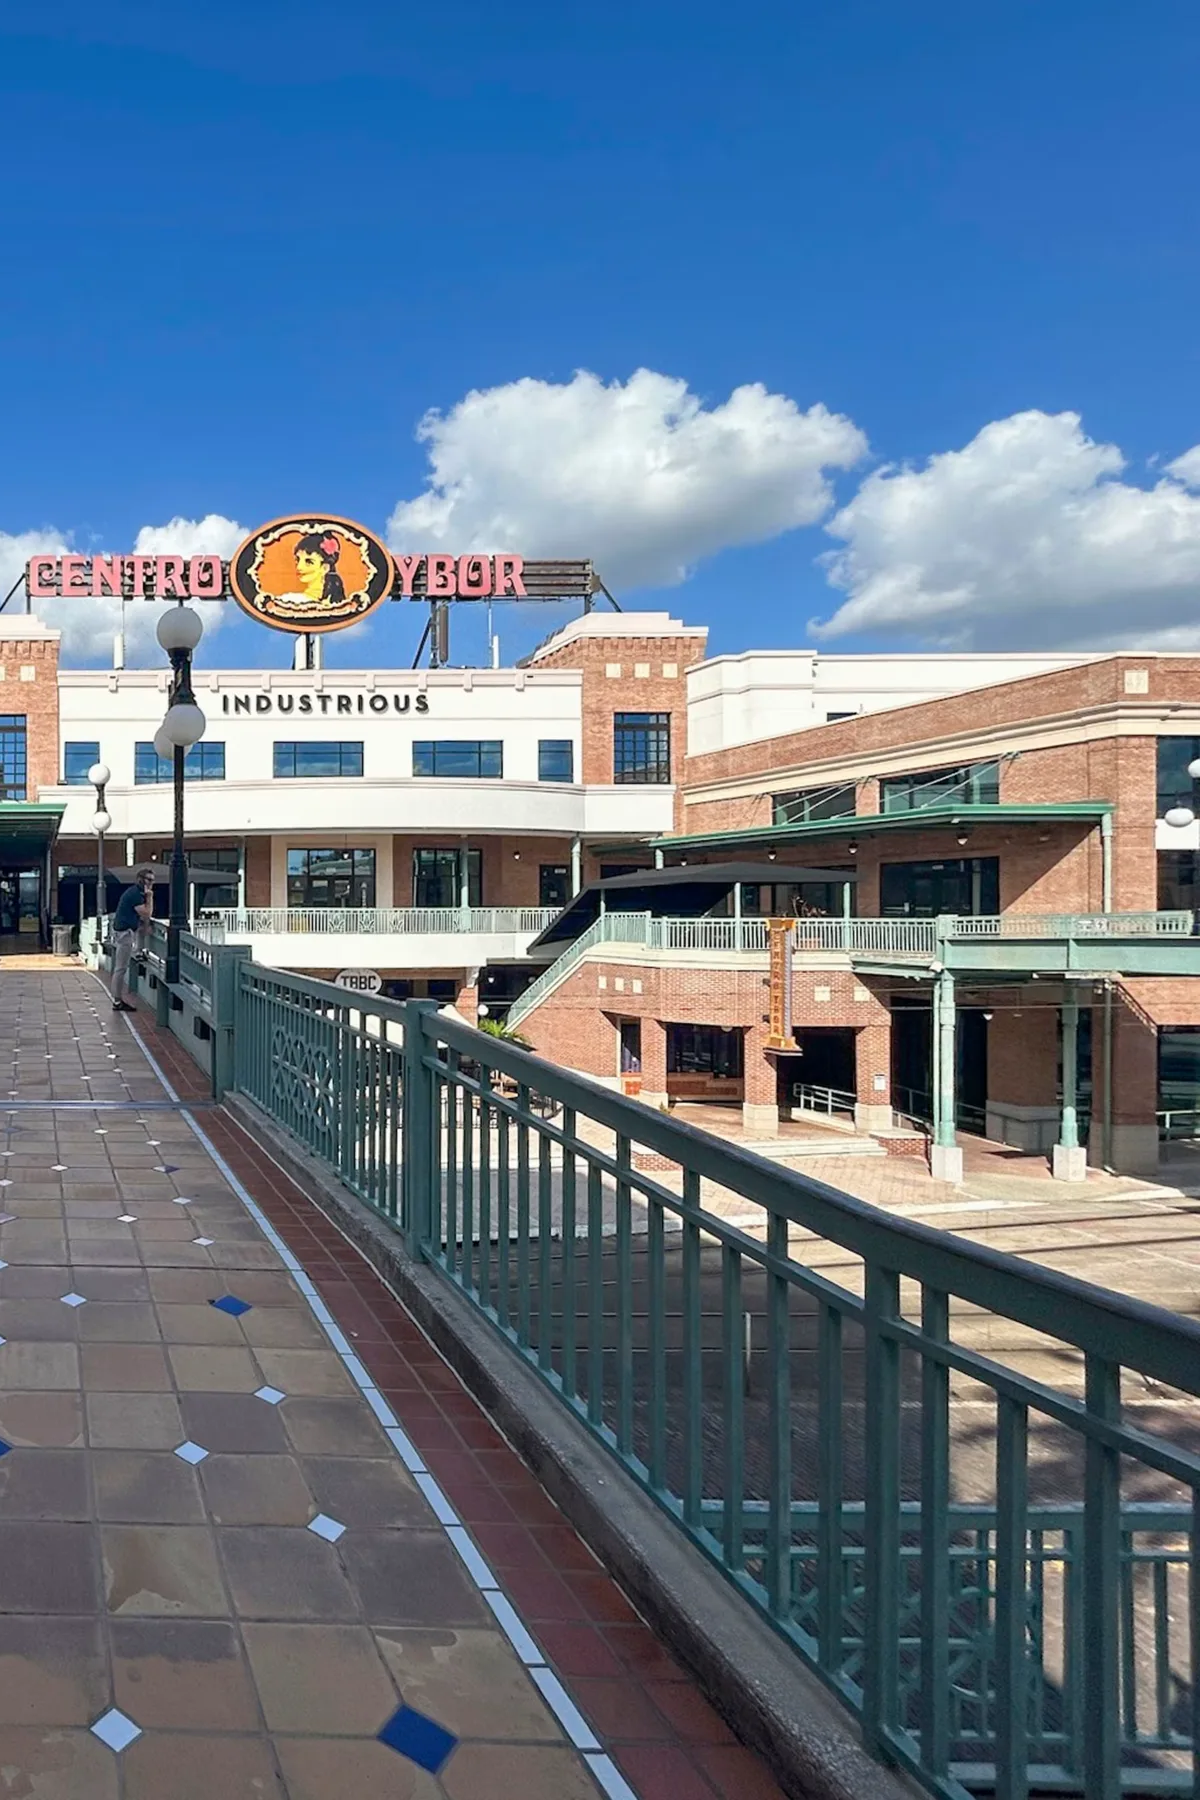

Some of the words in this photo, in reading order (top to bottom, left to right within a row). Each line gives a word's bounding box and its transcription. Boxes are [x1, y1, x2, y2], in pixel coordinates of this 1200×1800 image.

[29, 555, 223, 598] CENTRO
[393, 554, 528, 597] YBOR
[222, 694, 430, 714] INDUSTRIOUS
